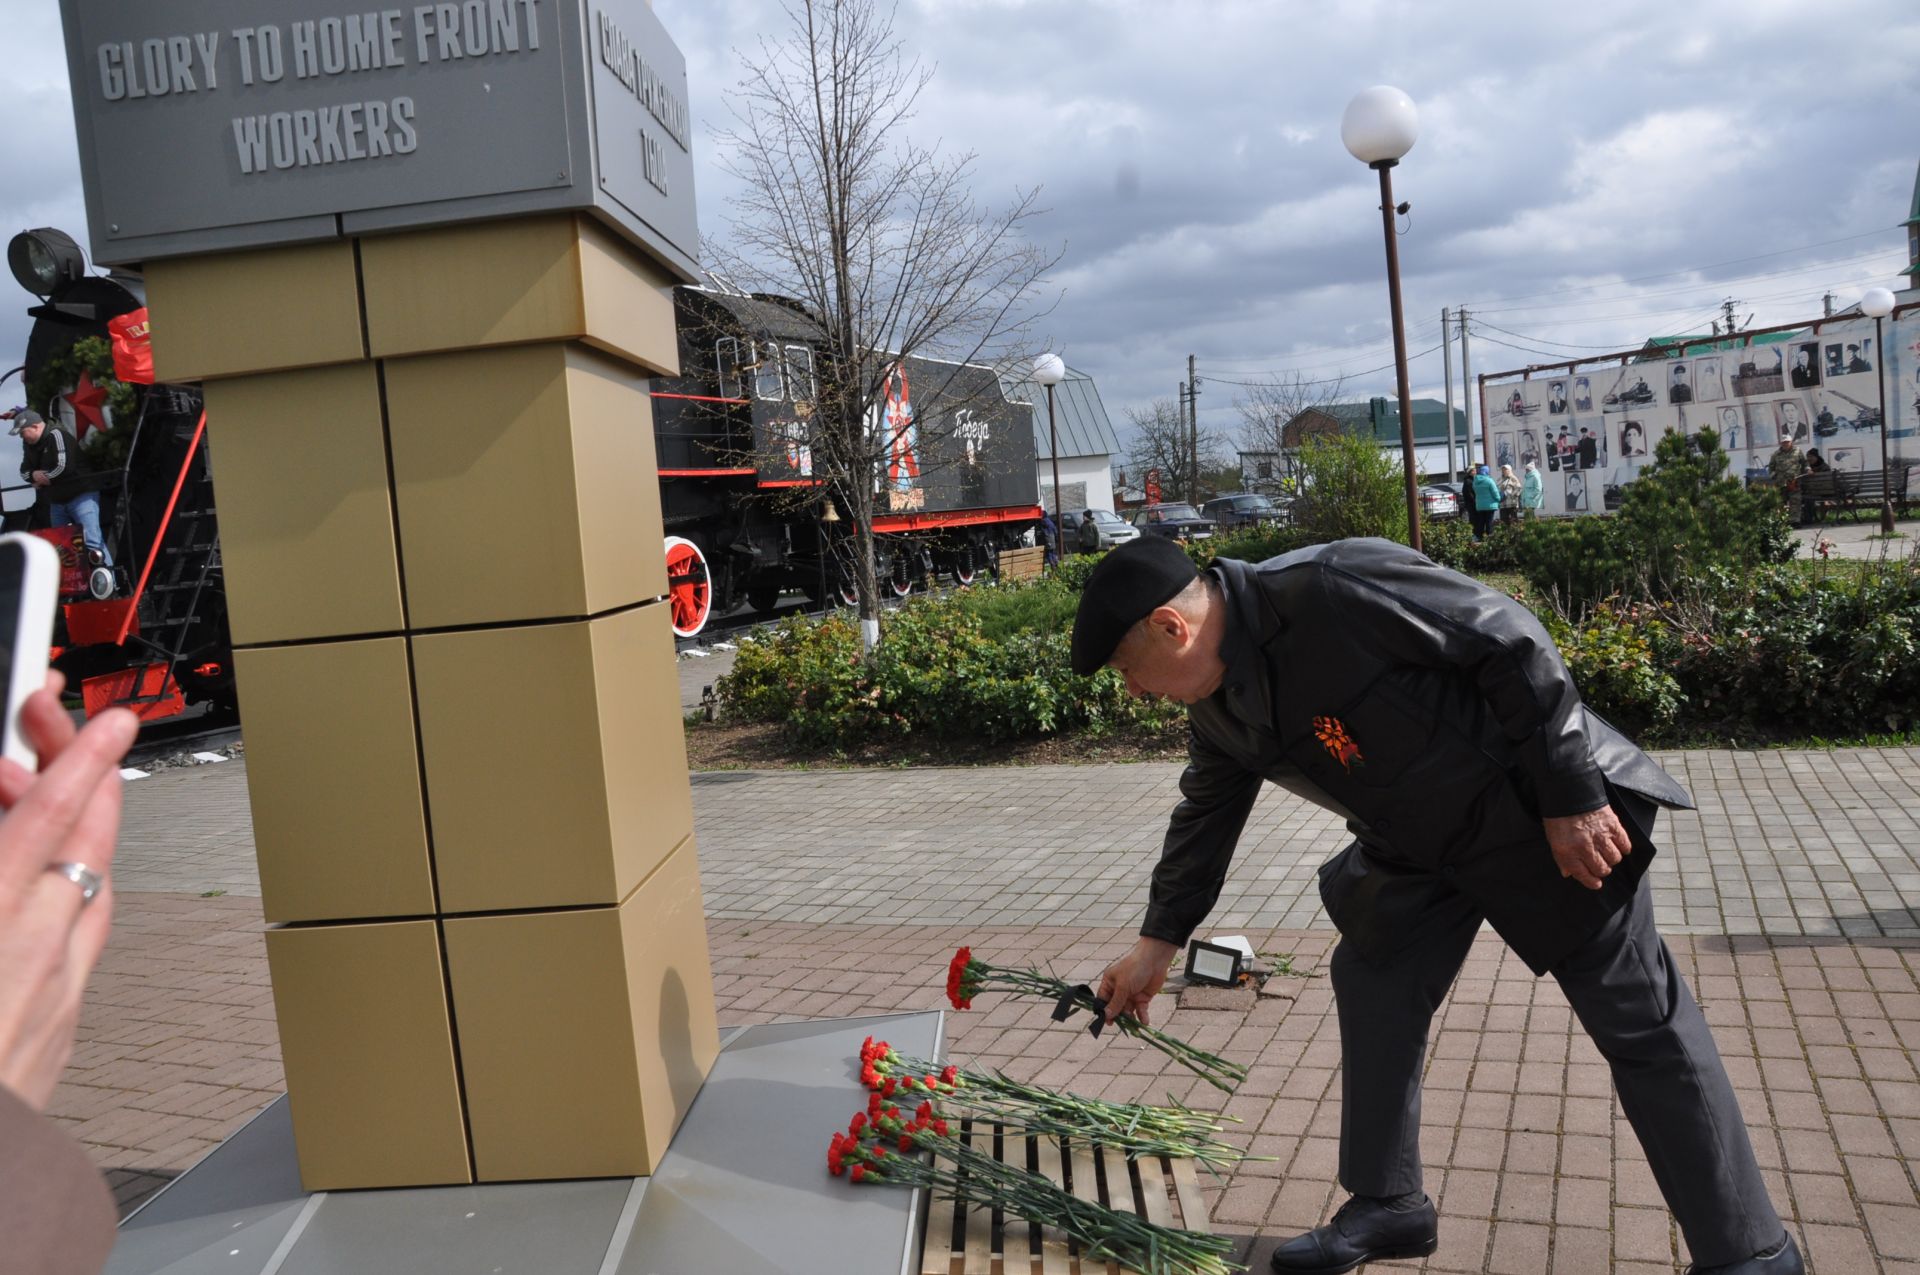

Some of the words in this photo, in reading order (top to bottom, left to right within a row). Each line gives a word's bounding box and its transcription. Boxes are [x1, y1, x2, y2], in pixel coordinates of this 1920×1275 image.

[97, 31, 219, 101] GLORY
[232, 24, 284, 85] TO
[291, 9, 405, 78] HOME
[413, 0, 540, 63] FRONT
[599, 9, 635, 93] СЛАВА
[231, 96, 417, 174] WORKERS
[953, 408, 990, 451] Победа
